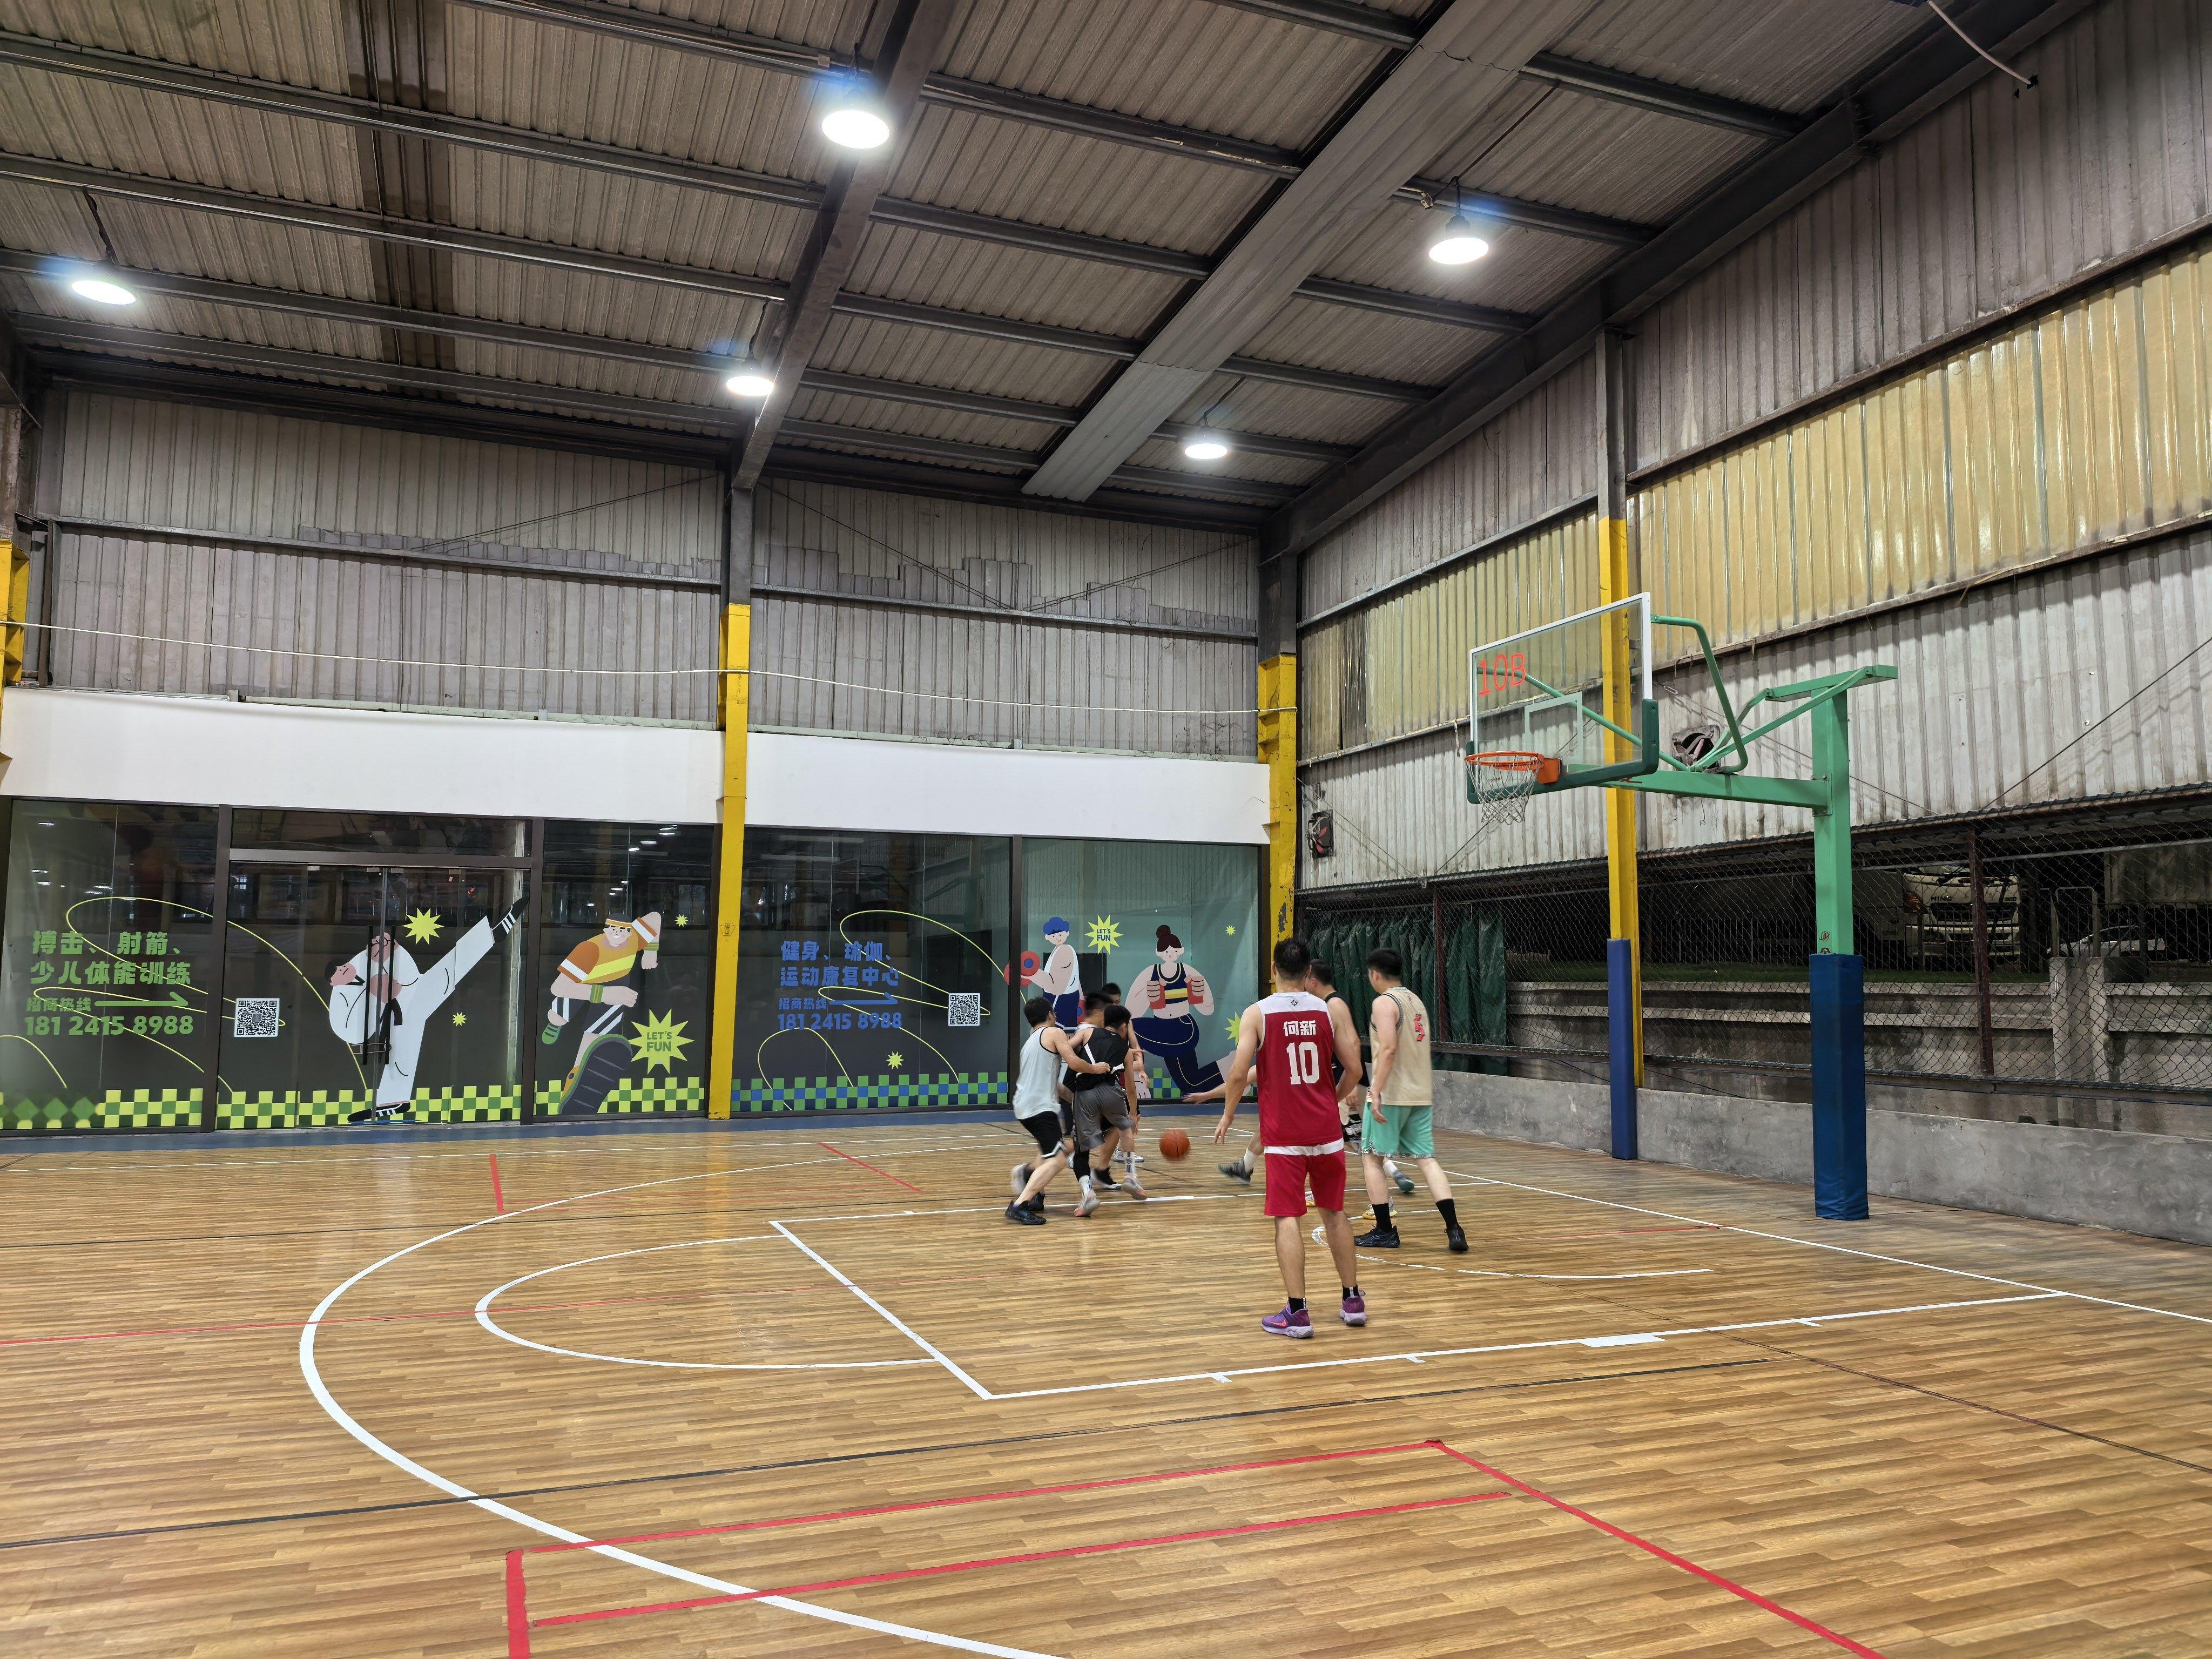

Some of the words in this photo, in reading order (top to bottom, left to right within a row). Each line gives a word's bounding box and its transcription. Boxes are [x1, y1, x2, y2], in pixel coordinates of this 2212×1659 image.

[780, 940, 891, 961] 健身、瑜伽、
[30, 960, 191, 984] 少儿体能训练
[780, 966, 899, 987] 运动康复中心
[24, 1016, 60, 1036] 181
[69, 1016, 125, 1036] 2415
[133, 1015, 193, 1035] 8988
[778, 1013, 806, 1030] 181
[811, 1013, 852, 1030] 2415
[858, 1012, 902, 1029] 8988
[1283, 1020, 1317, 1037] 何新
[646, 1031, 672, 1040] LET'S
[646, 1041, 671, 1052] FUN
[1286, 1042, 1319, 1085] 10
